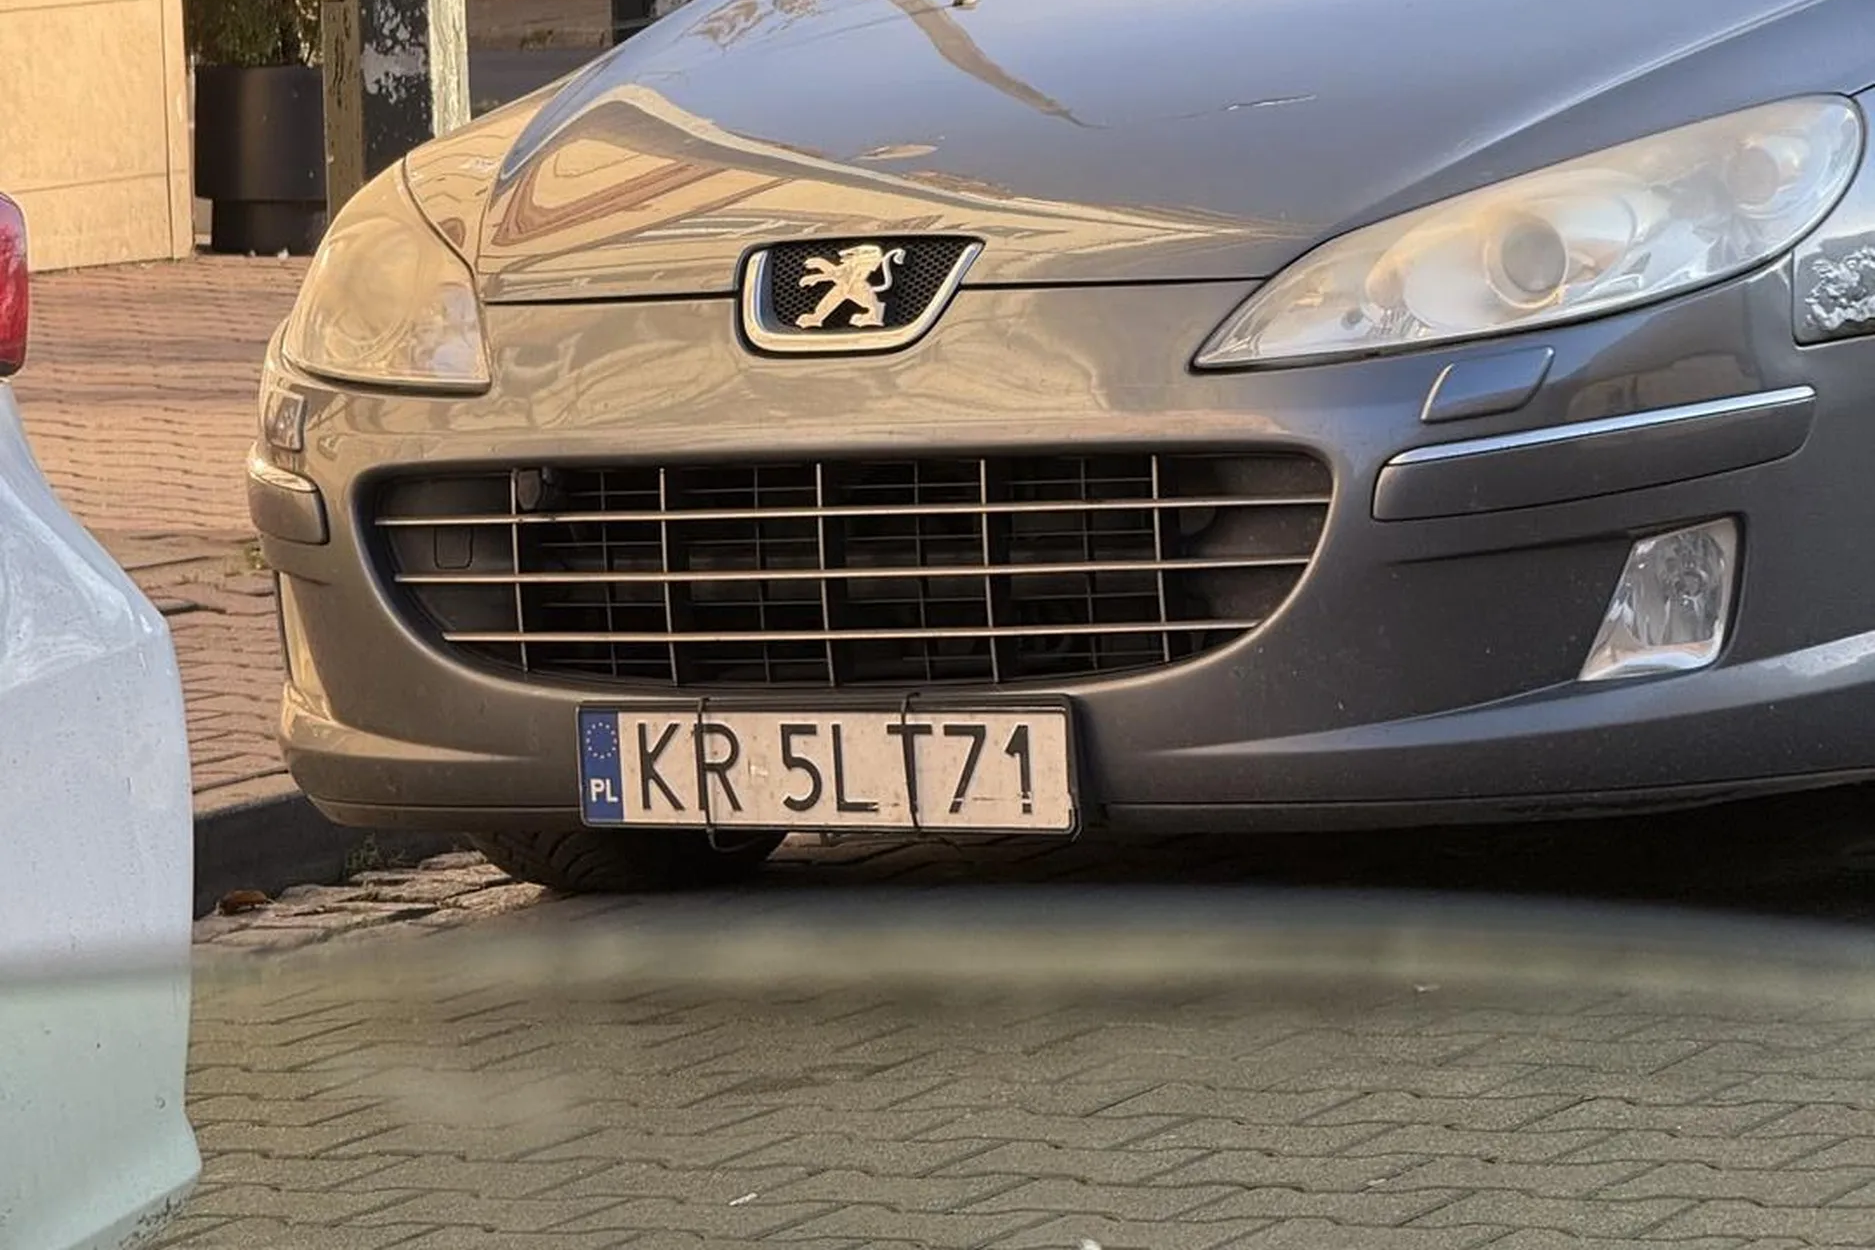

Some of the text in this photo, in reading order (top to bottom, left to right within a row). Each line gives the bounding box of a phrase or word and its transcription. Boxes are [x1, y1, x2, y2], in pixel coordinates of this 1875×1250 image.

[590, 778, 618, 802] PL
[636, 722, 1032, 814] KR 5LT71
